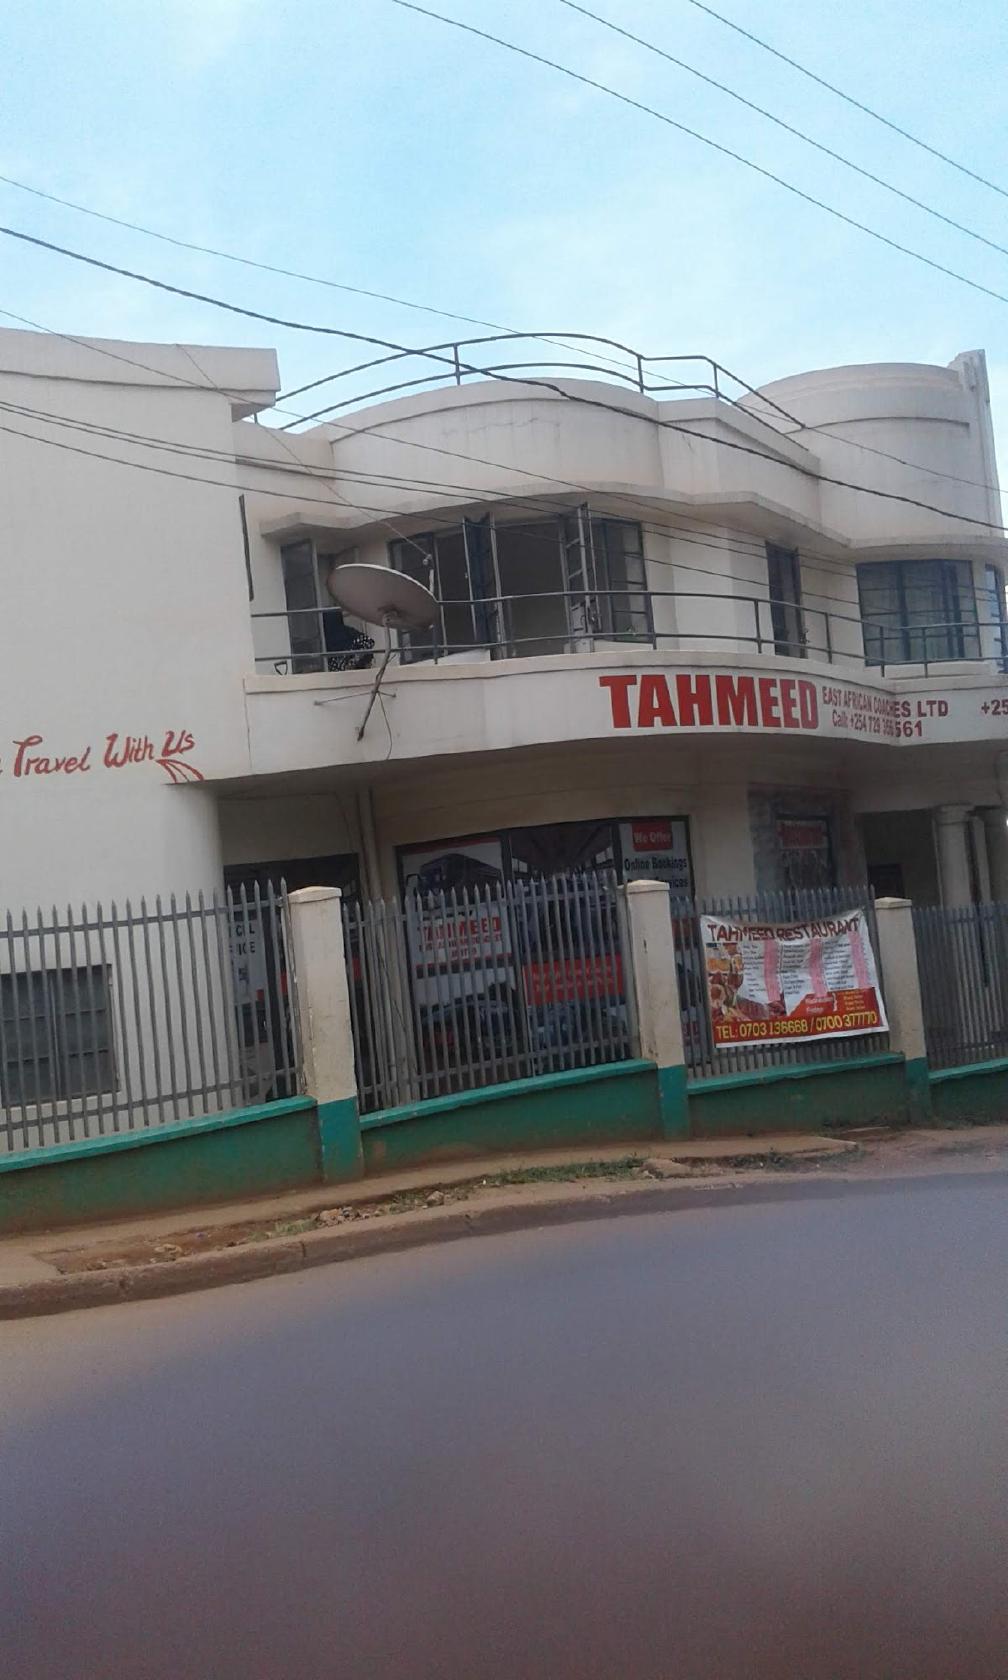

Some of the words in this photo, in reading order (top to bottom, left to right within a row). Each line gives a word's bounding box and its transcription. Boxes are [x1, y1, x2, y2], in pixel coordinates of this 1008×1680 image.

[599, 674, 819, 729] TAHMEED
[822, 686, 842, 707] EAST
[844, 690, 873, 712] AFRICAN
[873, 697, 911, 719] COACHES
[917, 701, 948, 717] LTD
[850, 713, 867, 733] +254
[13, 735, 91, 777] Travel
[104, 733, 154, 768] With
[161, 730, 195, 757] Us
[633, 832, 648, 843] We
[624, 858, 650, 871] Online
[651, 857, 687, 872] Bookings
[707, 923, 775, 942] TAHMEED
[776, 917, 860, 942] RESTAURANT
[716, 1025, 738, 1039] TEL:
[739, 1021, 767, 1037] 0703
[769, 1017, 808, 1035] 136668
[816, 1013, 843, 1032] 0700
